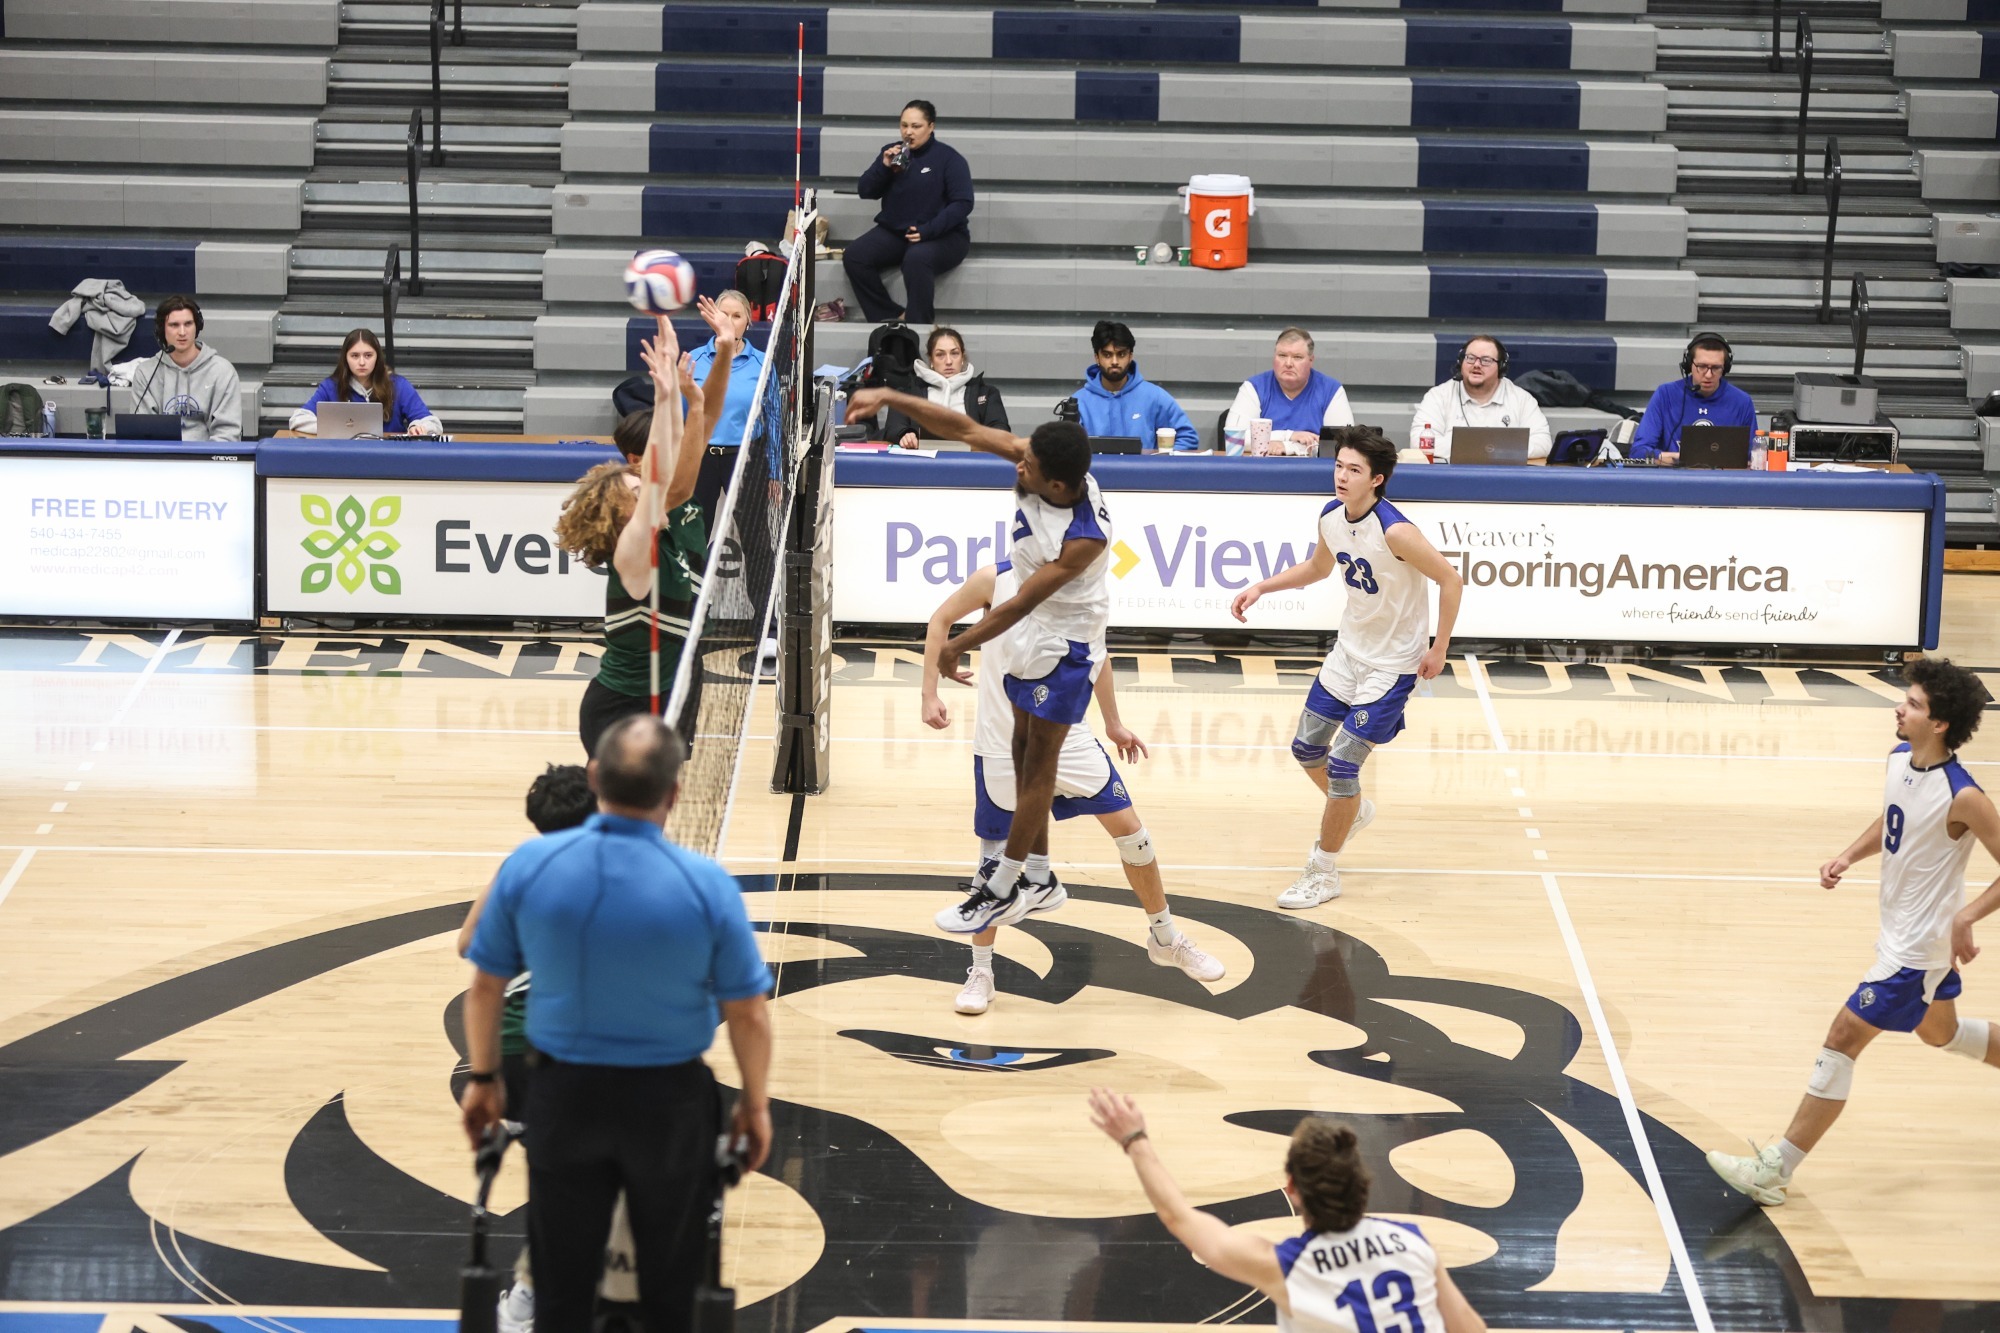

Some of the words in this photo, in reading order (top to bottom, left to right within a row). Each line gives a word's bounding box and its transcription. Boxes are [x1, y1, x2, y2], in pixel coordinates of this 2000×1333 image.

[31, 497, 96, 518] FREE
[104, 499, 229, 521] DELIVERY
[29, 527, 123, 541] 540-434-7455
[1438, 521, 1556, 548] Weaver's
[1336, 551, 1380, 595] 23
[1117, 597, 1186, 609] FEDERAL
[1256, 600, 1306, 611] UNION
[1621, 606, 1665, 620] where
[1666, 602, 1723, 624] friends
[1725, 608, 1759, 621] send
[1760, 603, 1819, 626] friends
[1884, 803, 1905, 855] 9
[1311, 1232, 1408, 1275] ROYALS
[1334, 1269, 1427, 1333] 13
